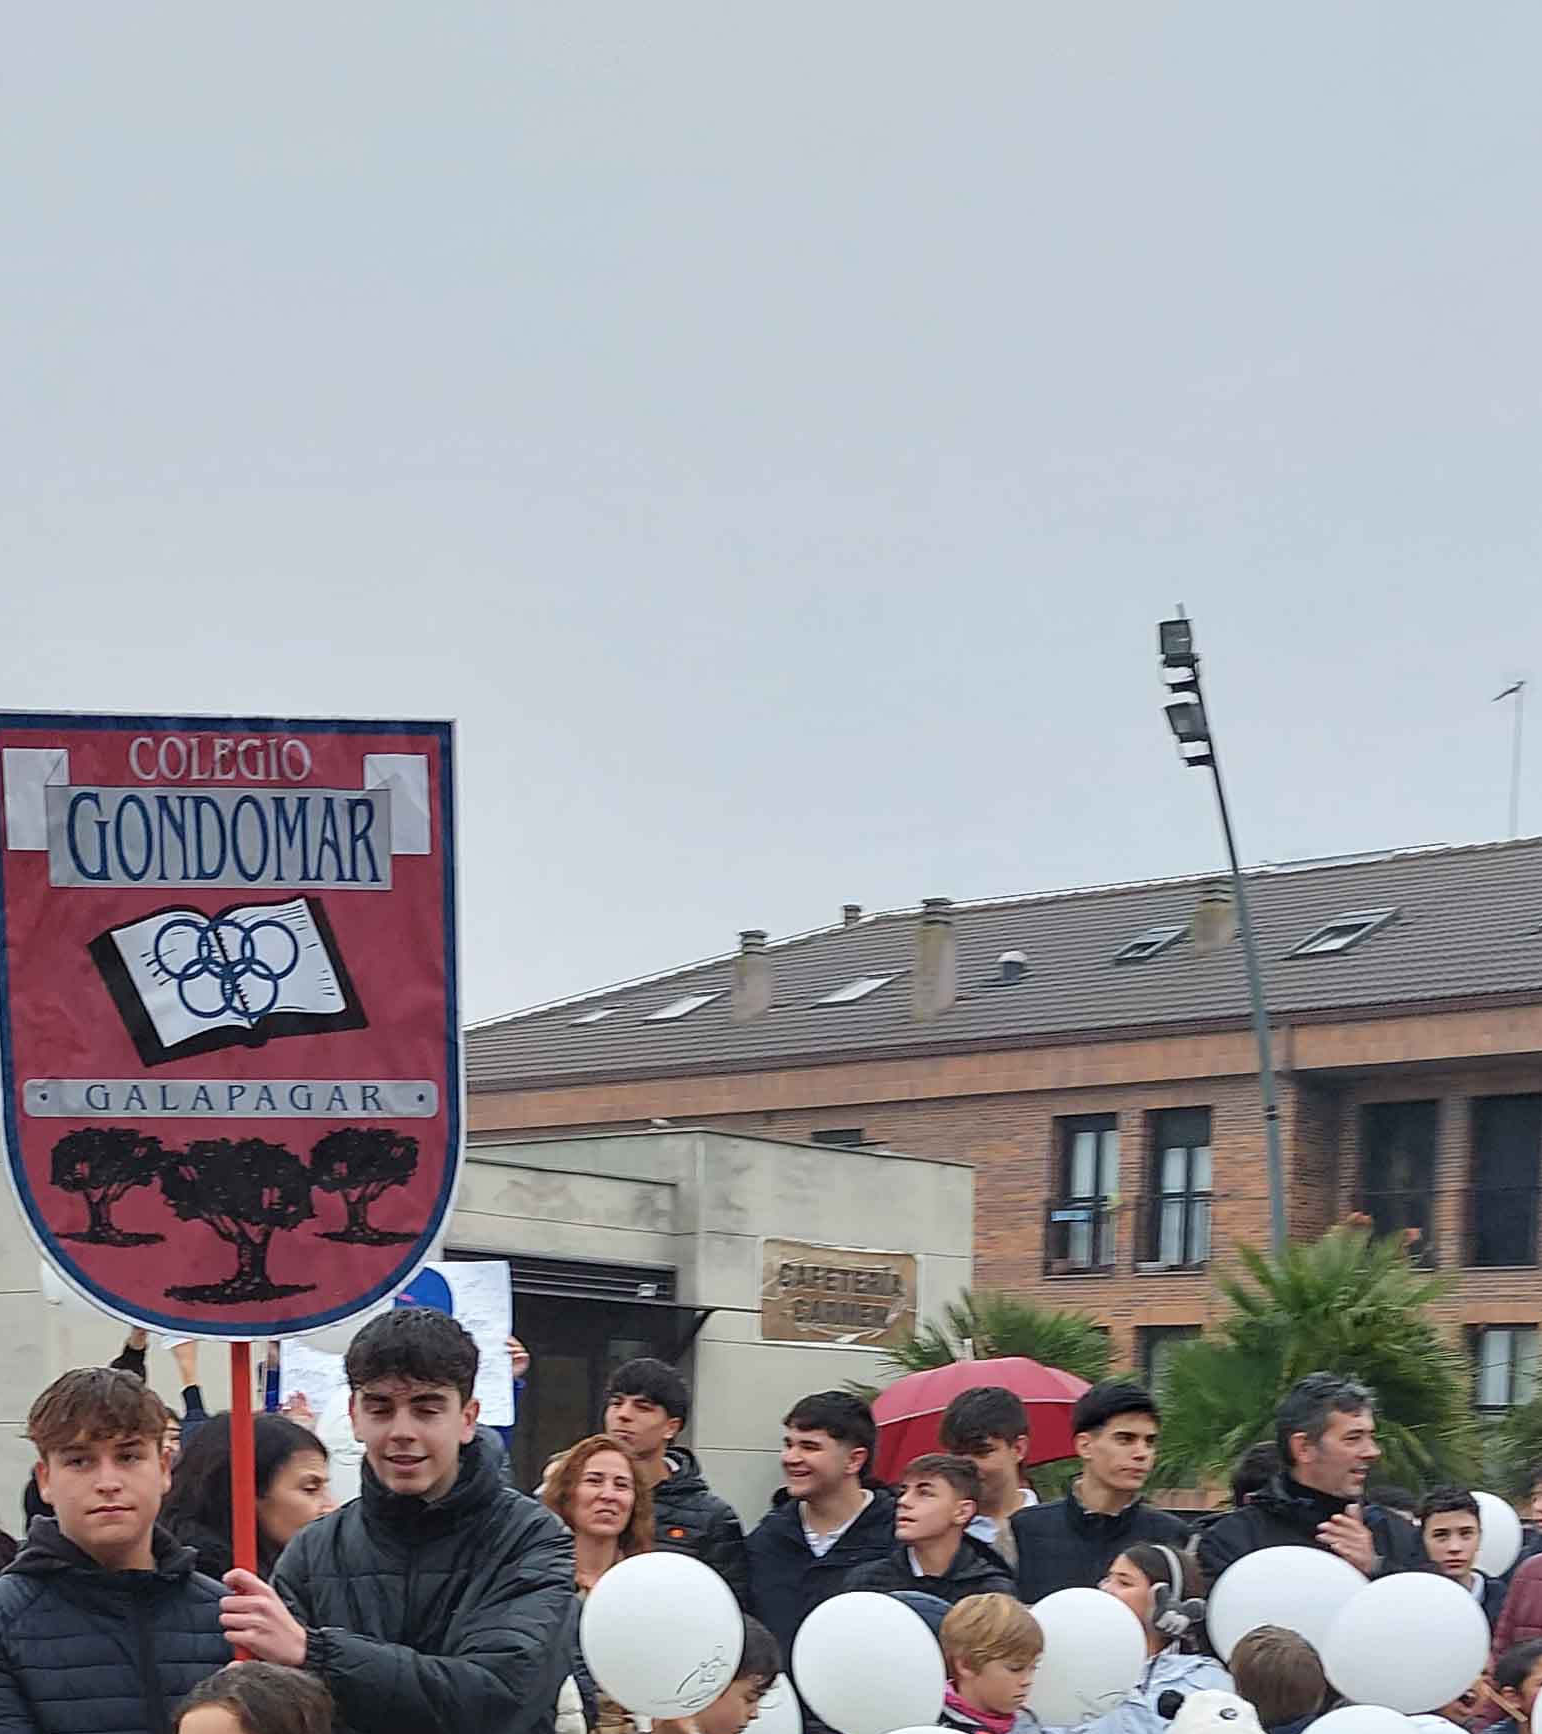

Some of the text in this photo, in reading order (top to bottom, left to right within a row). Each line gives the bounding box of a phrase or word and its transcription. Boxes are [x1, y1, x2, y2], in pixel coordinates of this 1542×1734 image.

[128, 736, 313, 782] COLEGIO
[66, 790, 383, 884] GONDOMAR
[84, 1083, 384, 1113] GALAPAGAR
